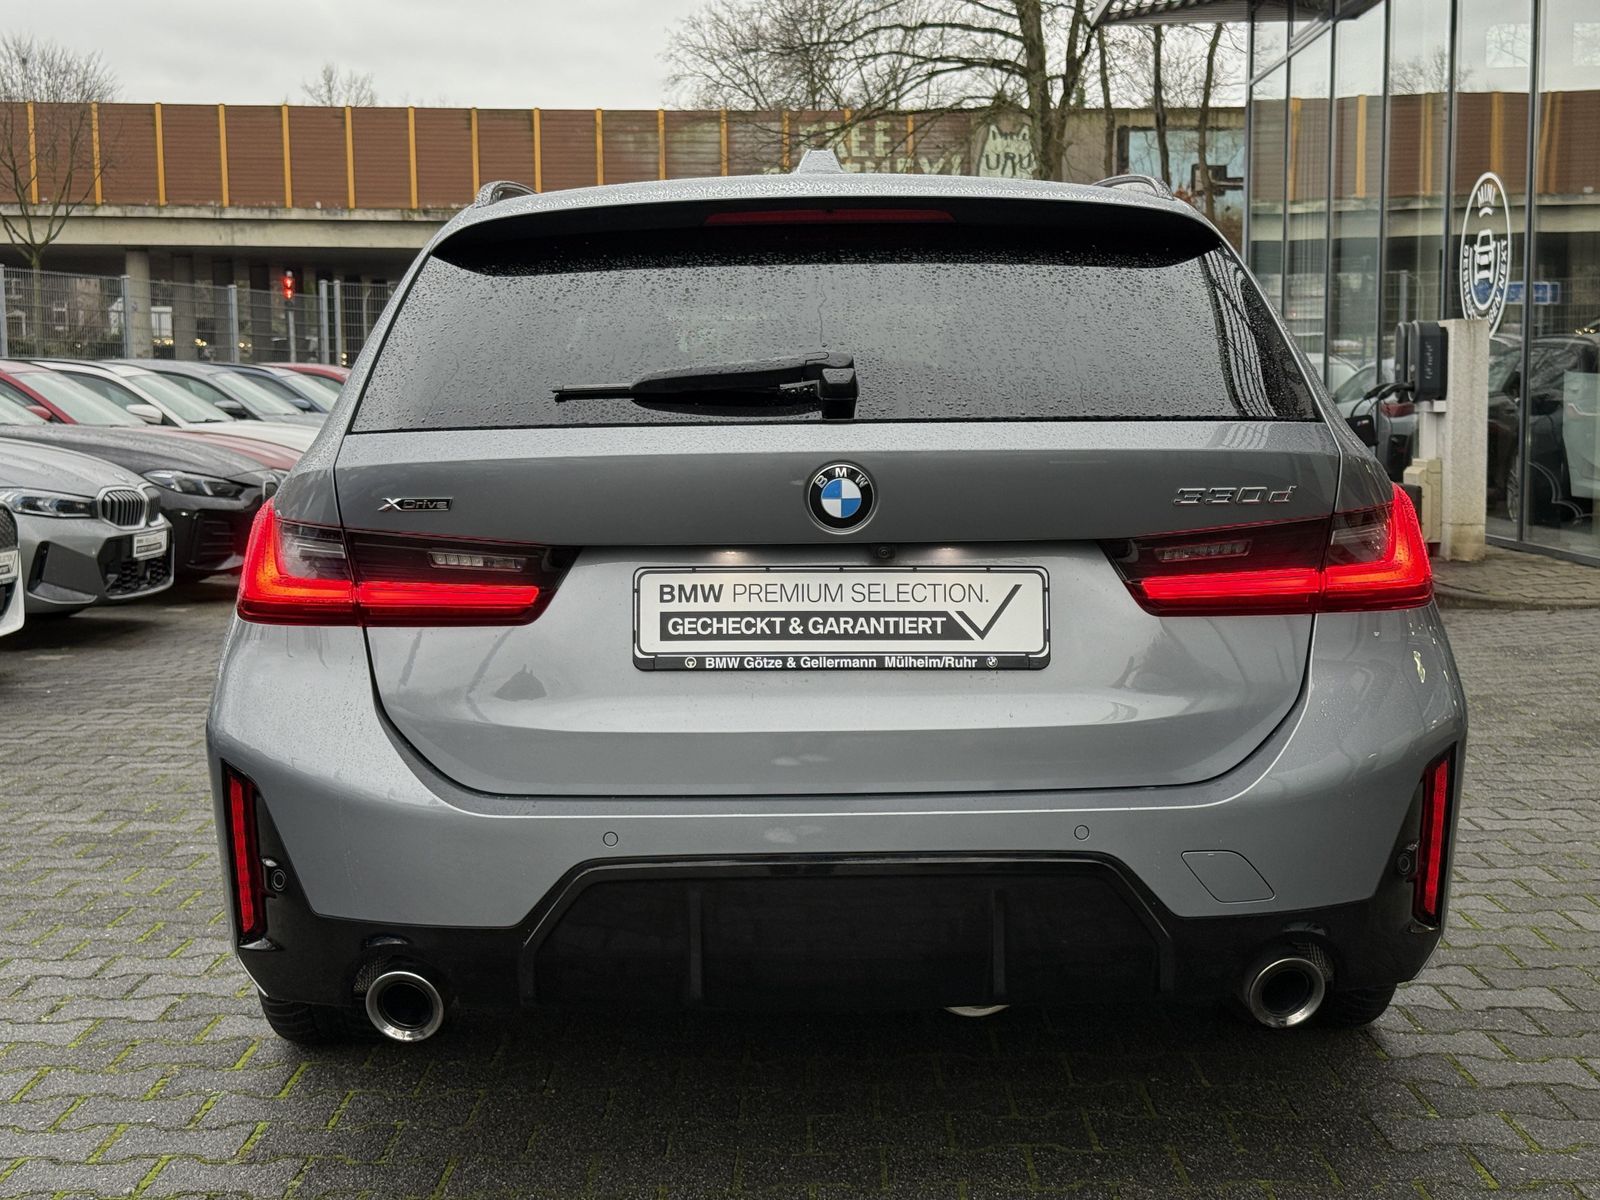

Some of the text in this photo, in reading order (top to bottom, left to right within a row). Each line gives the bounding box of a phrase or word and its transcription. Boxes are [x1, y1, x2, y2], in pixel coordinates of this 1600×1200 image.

[1477, 183, 1496, 208] MINI
[814, 467, 869, 489] BMW
[1173, 485, 1297, 505] 330d
[659, 582, 989, 603] BMW PREMIUM SELECTION.
[667, 616, 947, 635] GECHECKT & GARANTIERT
[705, 656, 978, 669] BMW Götze & Gellermann Mülheim/Ruhr
